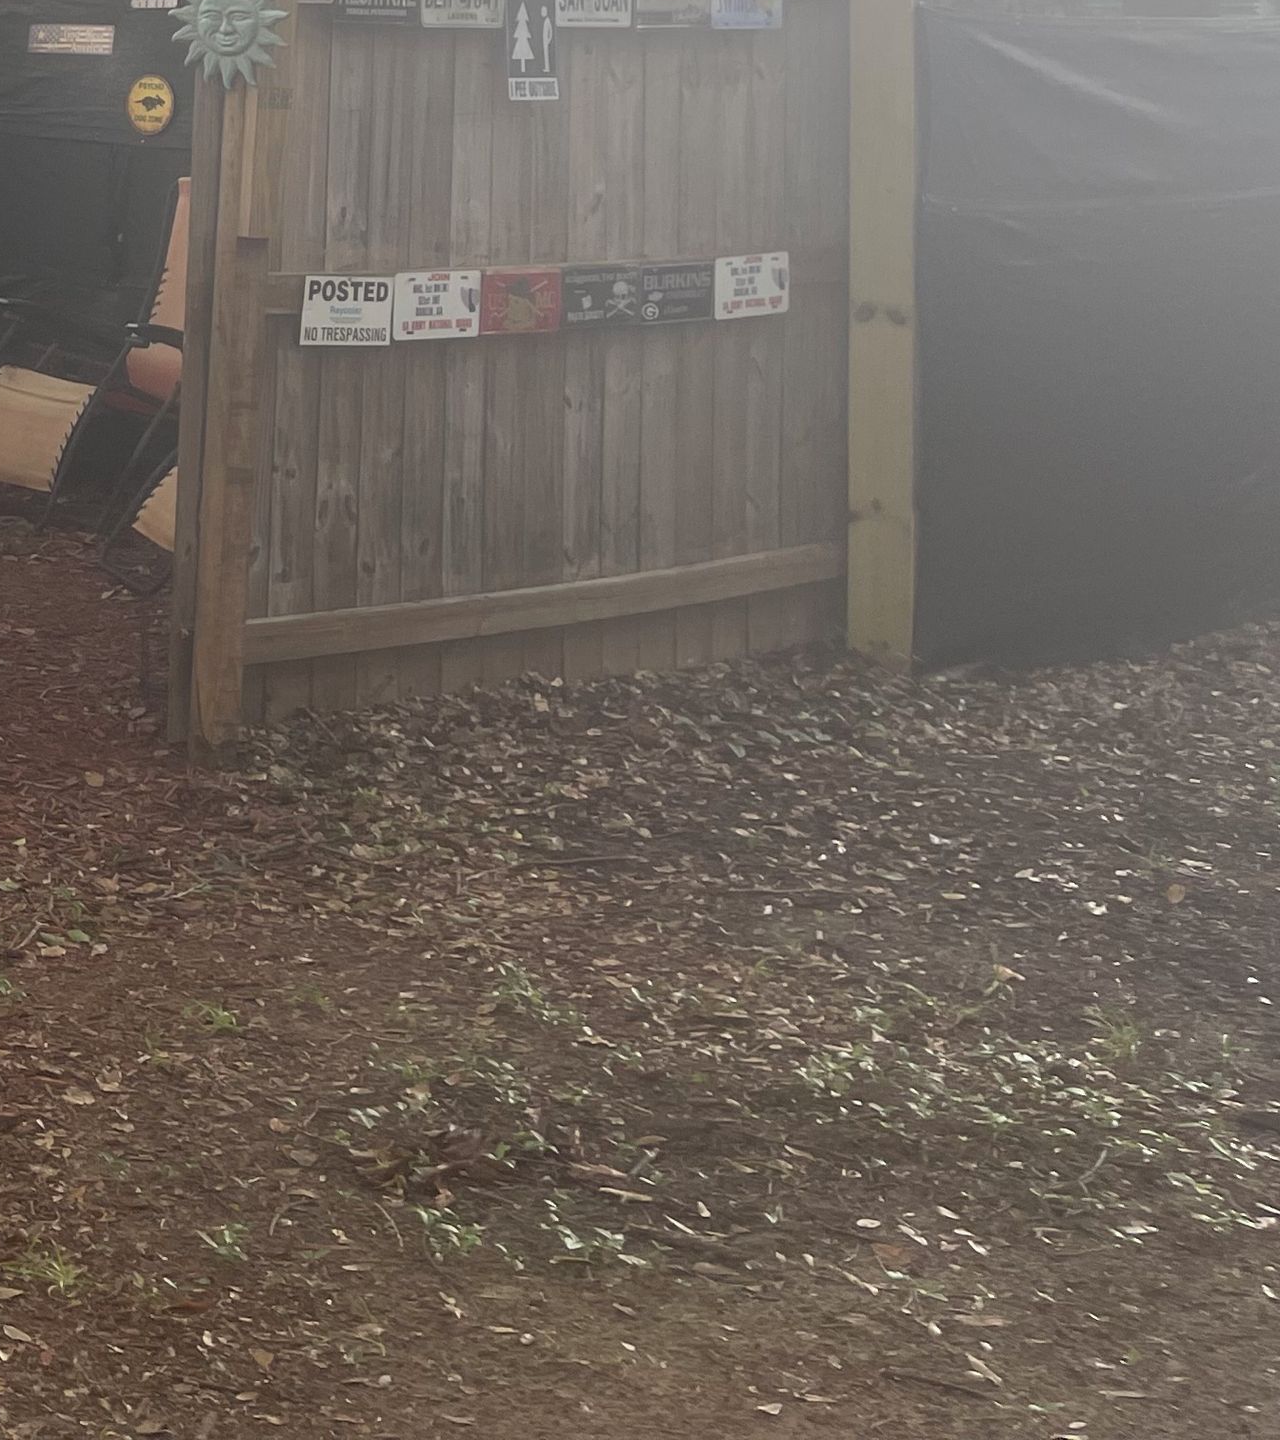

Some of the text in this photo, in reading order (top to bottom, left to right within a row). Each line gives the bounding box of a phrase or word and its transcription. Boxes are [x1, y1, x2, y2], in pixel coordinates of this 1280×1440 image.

[514, 80, 528, 97] PEE
[427, 273, 450, 282] JOIN
[643, 271, 712, 291] BURKINS
[308, 279, 389, 302] POSTED
[304, 327, 387, 342] NO TRESPASSING
